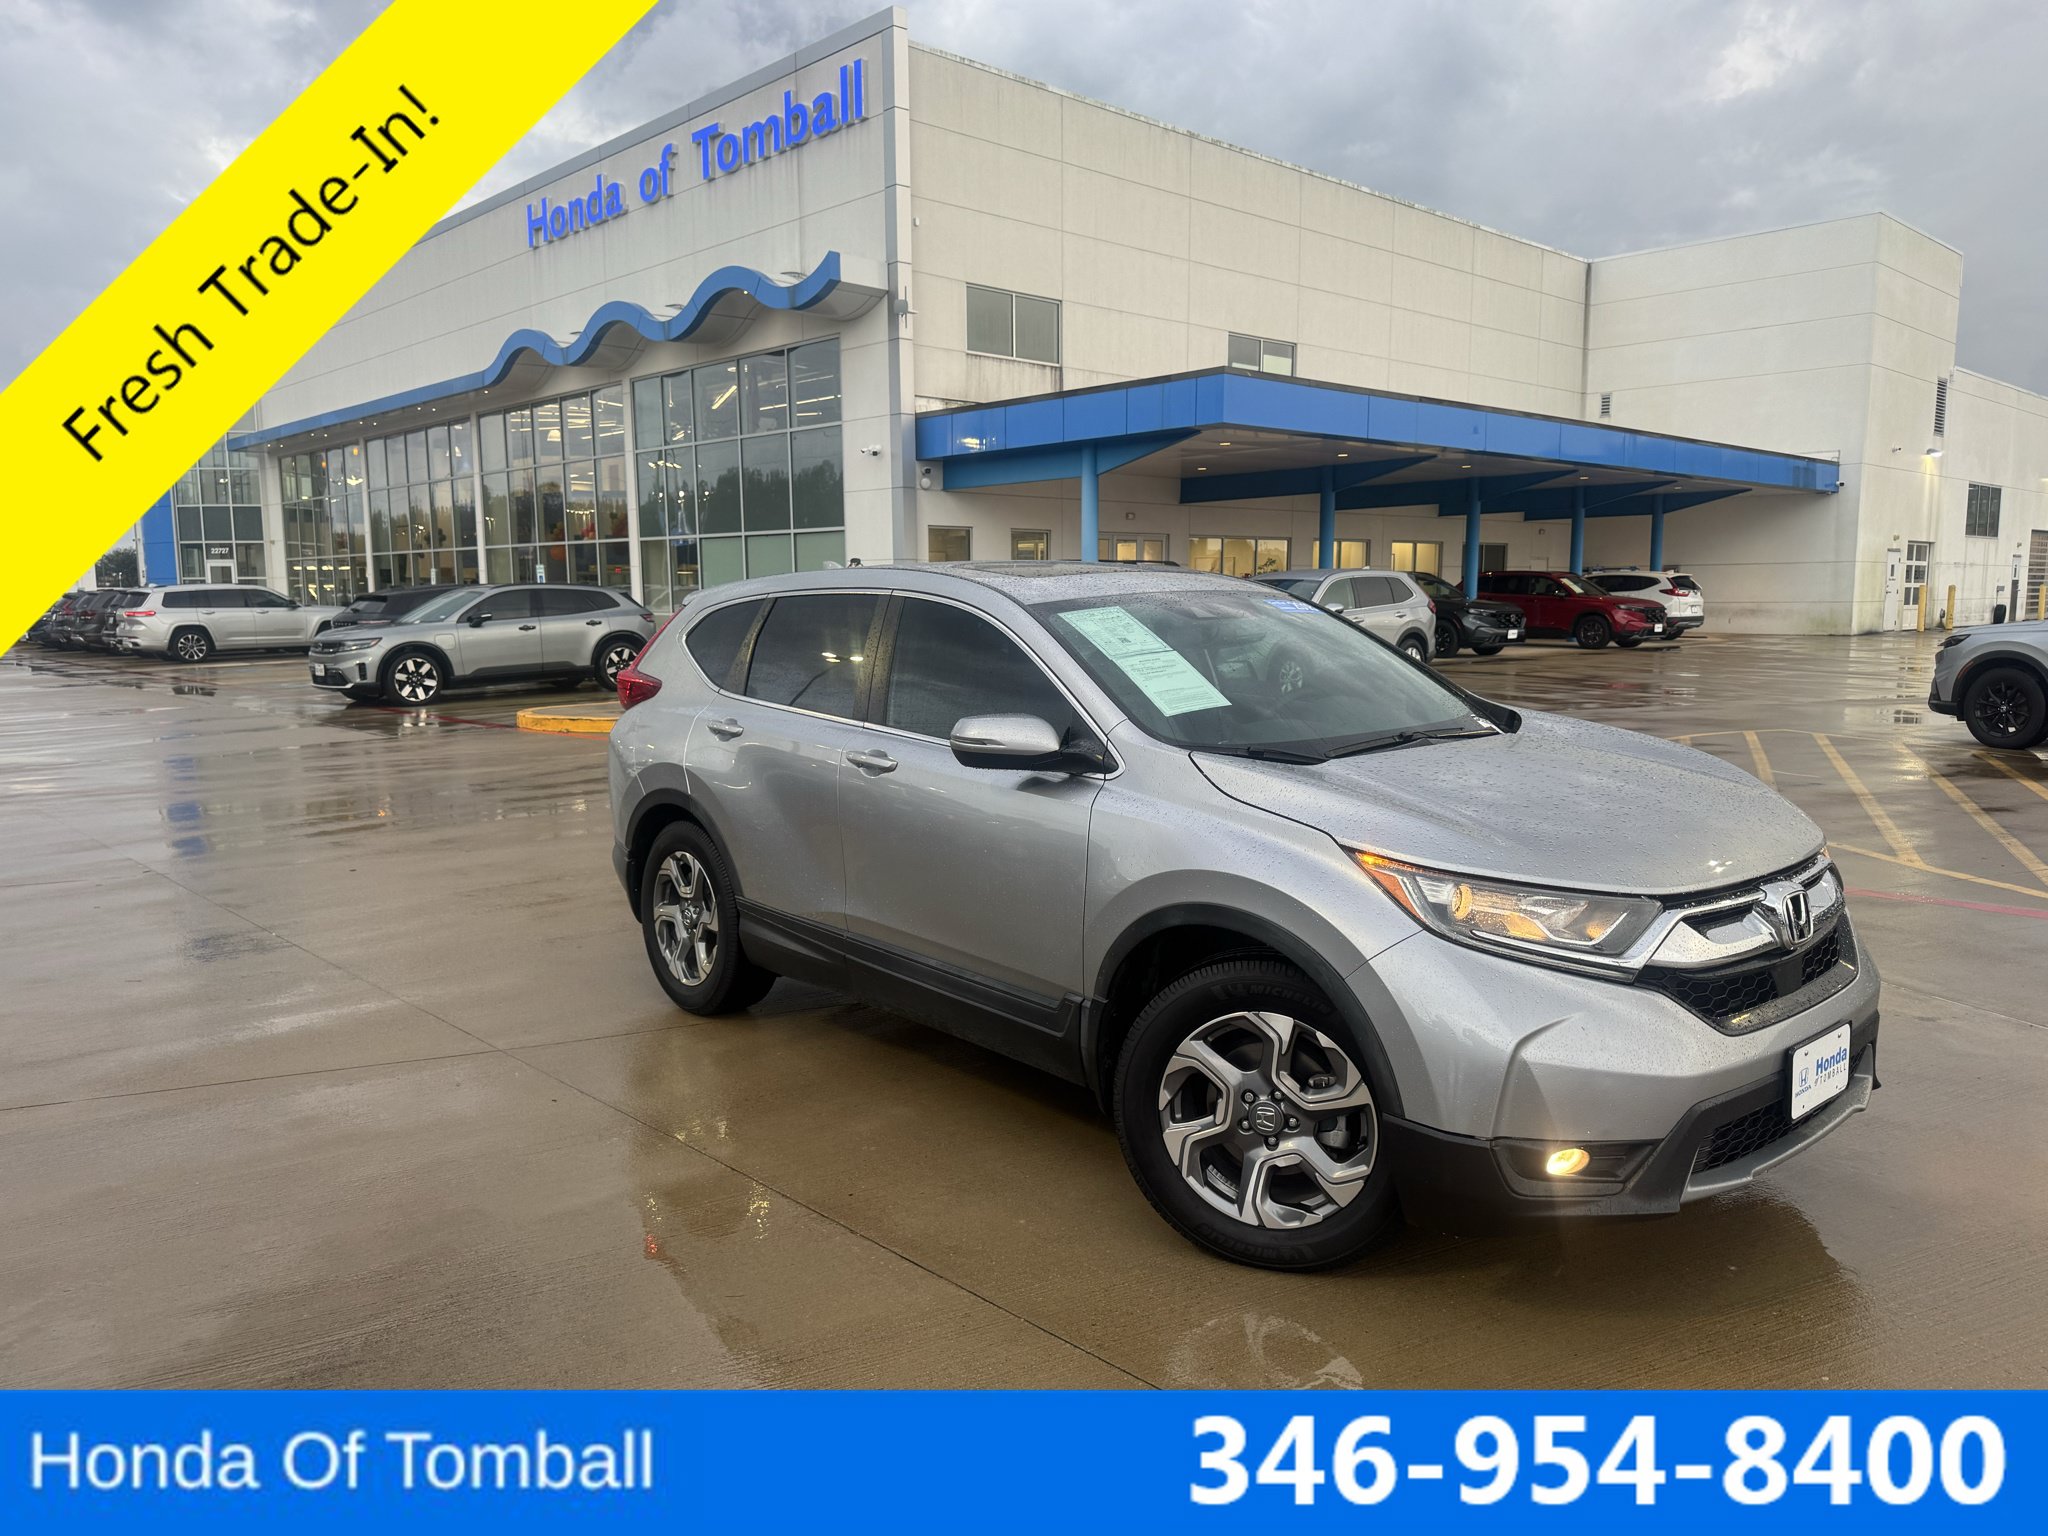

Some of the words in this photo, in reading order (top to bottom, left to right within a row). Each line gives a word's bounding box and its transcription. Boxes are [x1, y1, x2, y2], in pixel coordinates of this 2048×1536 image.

[527, 175, 627, 247] Honda
[639, 142, 677, 203] of
[691, 58, 867, 181] Tomball
[211, 547, 229, 555] 22727
[1815, 1046, 1848, 1077] Honda
[1820, 1063, 1847, 1084] TOMBALL
